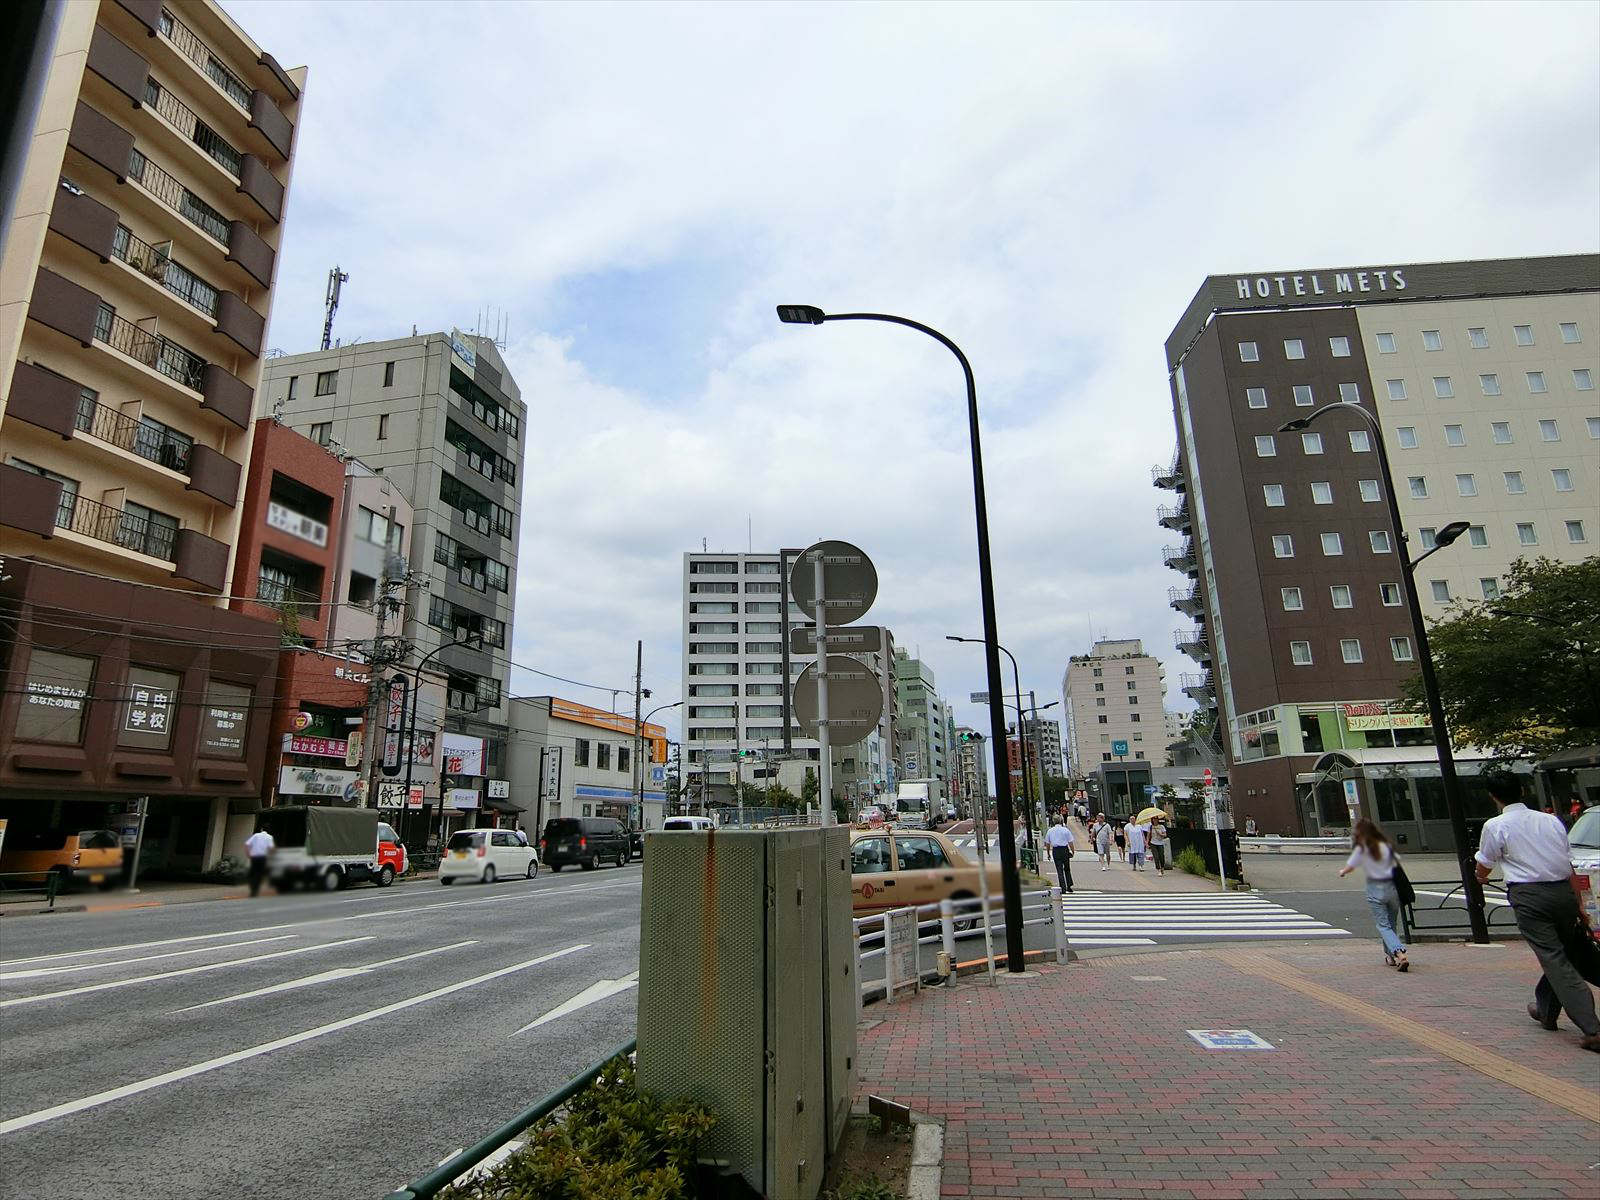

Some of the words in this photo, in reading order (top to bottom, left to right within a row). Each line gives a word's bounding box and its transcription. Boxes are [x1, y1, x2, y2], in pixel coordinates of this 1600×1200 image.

[1236, 275, 1325, 299] HOTEL
[1335, 270, 1406, 293] METS
[28, 682, 87, 698] はじめませんか
[135, 690, 168, 709] 自由
[131, 710, 166, 728] 学校
[292, 741, 325, 753] なかむら
[447, 757, 462, 772] 花
[380, 784, 406, 807] 餃子
